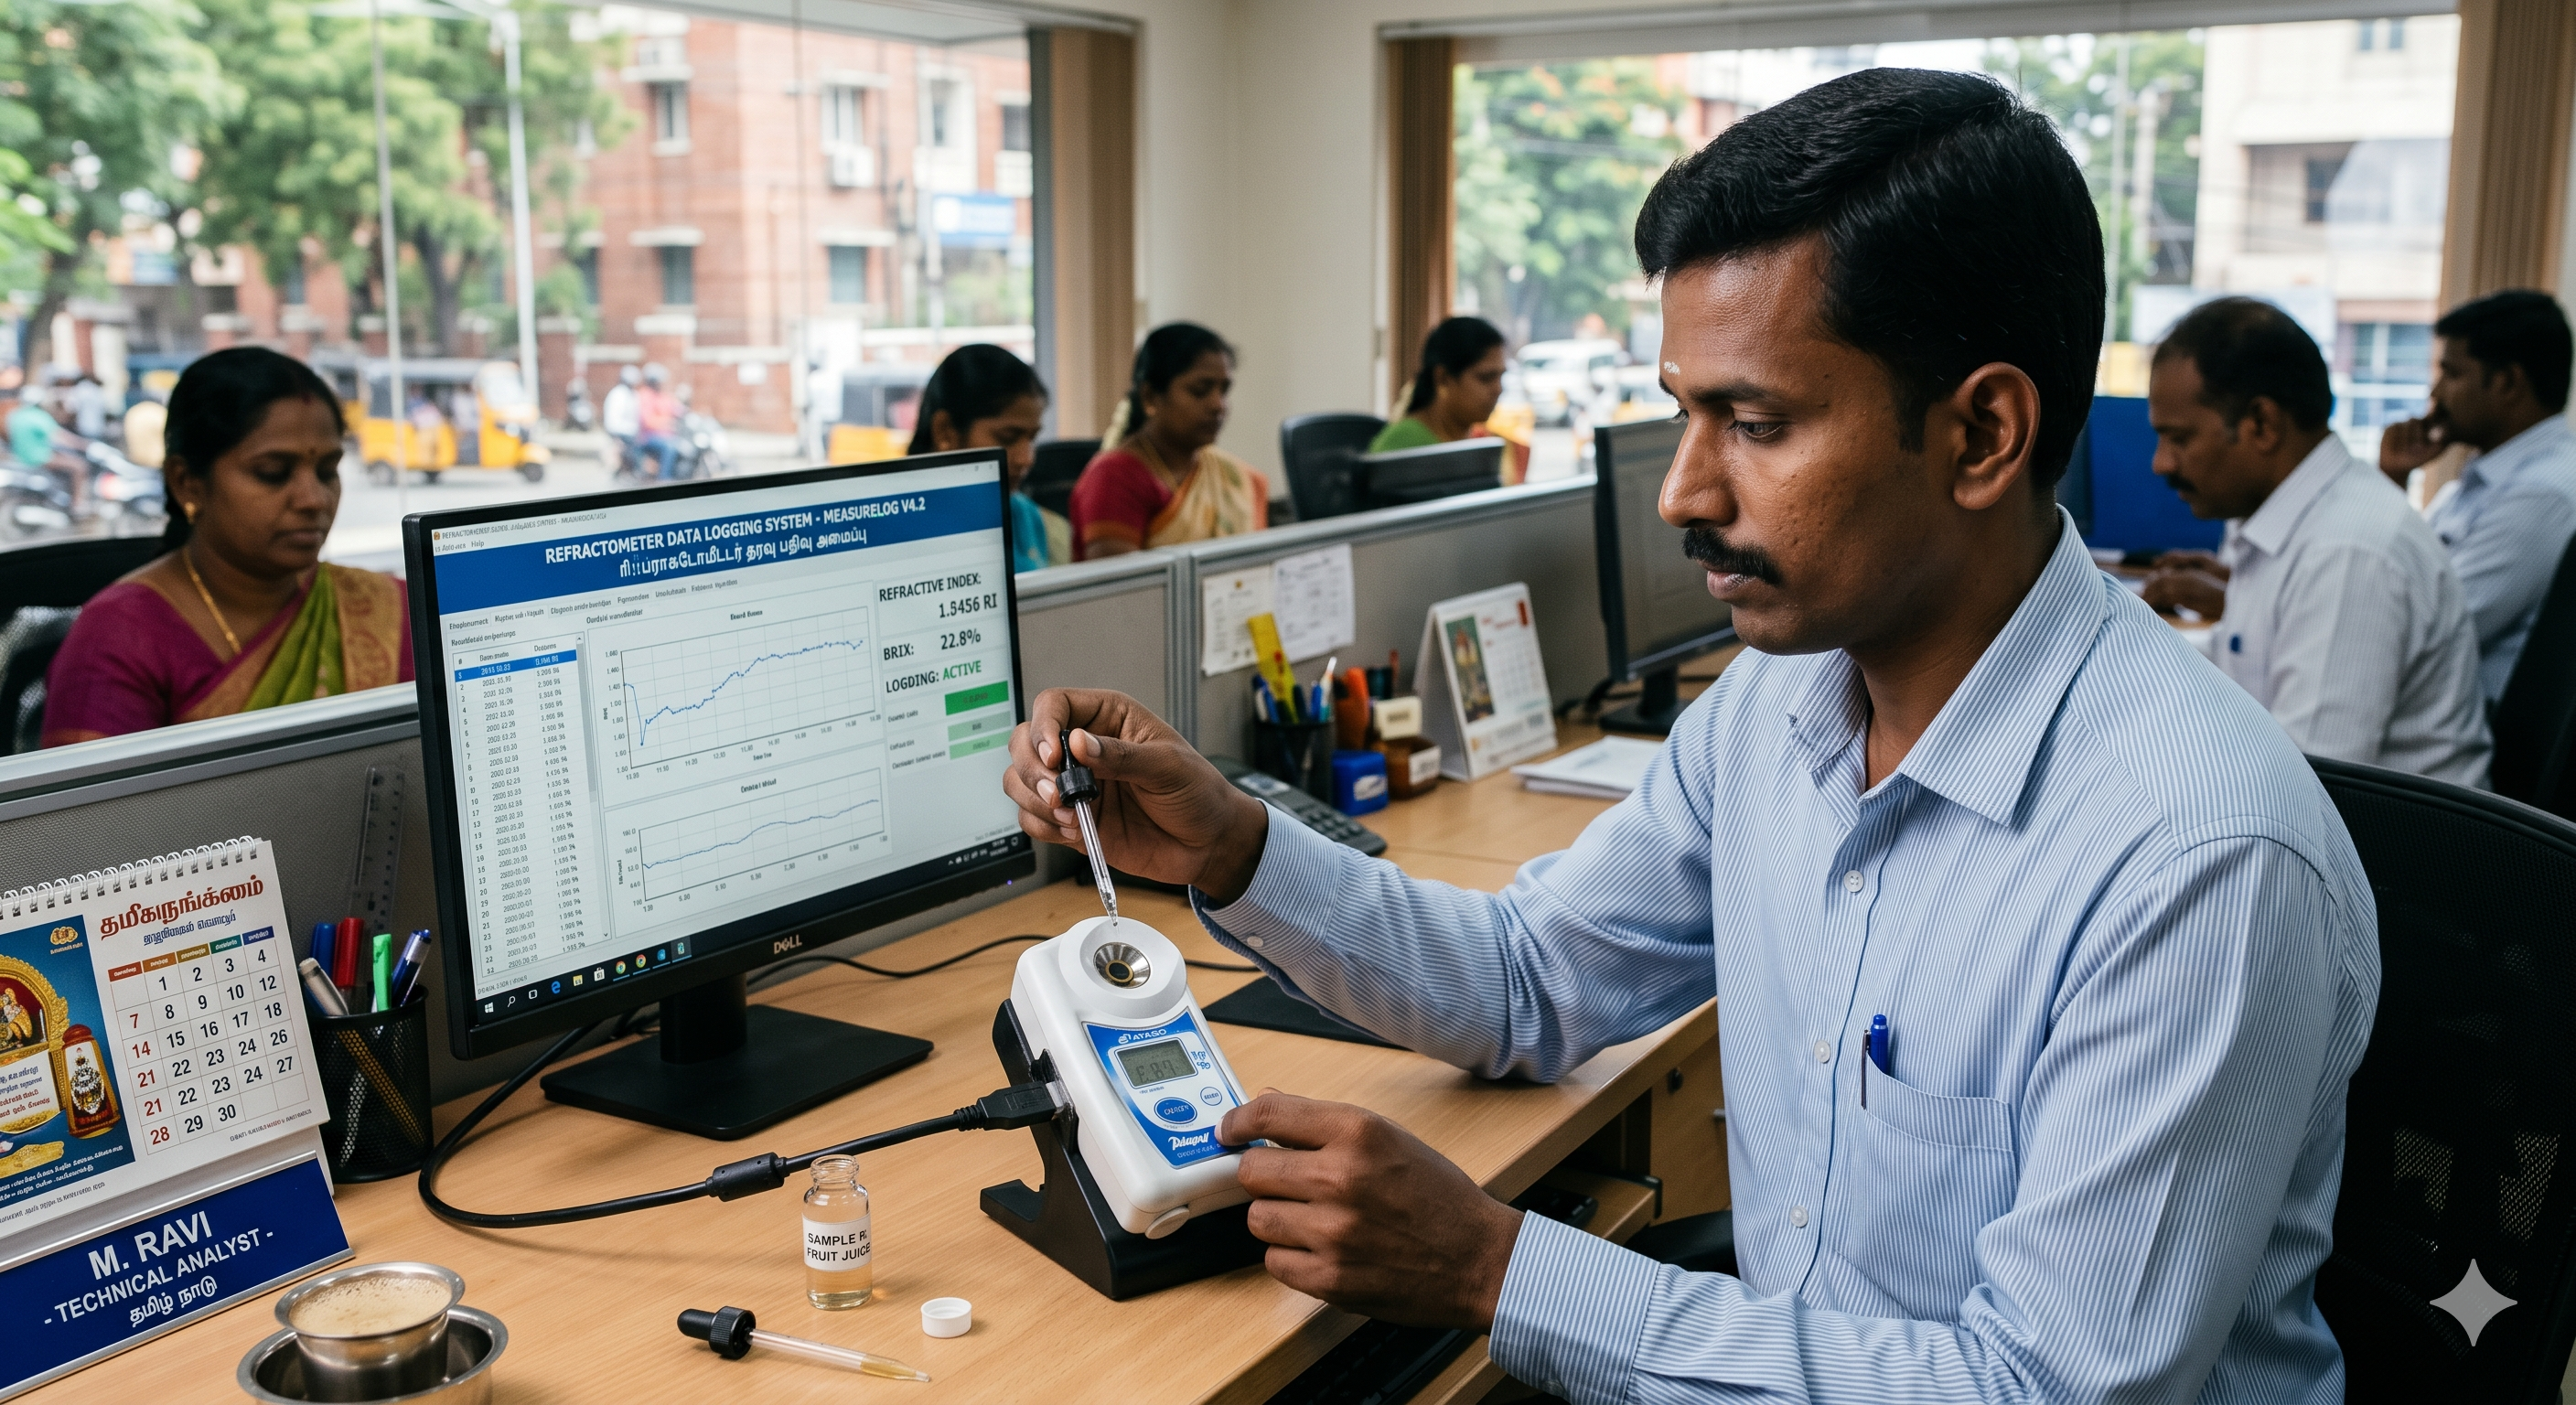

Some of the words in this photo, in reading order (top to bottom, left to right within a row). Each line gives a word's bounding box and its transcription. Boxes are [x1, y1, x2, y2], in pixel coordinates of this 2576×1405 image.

[545, 533, 664, 563] REFRACTOMETER
[667, 528, 703, 547] DATA
[703, 519, 763, 542] LOGGING
[765, 512, 812, 532] SYSTEM
[823, 500, 899, 524] MEASURELOG
[901, 497, 926, 513] V4.2
[879, 578, 944, 602] REFRACTIVE
[947, 573, 982, 590] INDEX:
[983, 593, 997, 609] RI
[884, 643, 914, 660] BRIX:
[940, 628, 981, 649] 22.8%
[886, 671, 939, 693] LOGDING:
[942, 660, 982, 681] ACTIVE
[480, 888, 488, 896] 20
[158, 976, 167, 992] 1
[192, 967, 203, 982] 2
[225, 958, 234, 972] 3
[257, 949, 267, 963] 4
[129, 1014, 139, 1029] 7
[165, 1004, 175, 1020] 8
[198, 994, 208, 1010] 9
[227, 984, 244, 1001] 10
[259, 975, 277, 992] 12
[132, 1041, 151, 1058] 14
[166, 1031, 185, 1048] 15
[200, 1021, 219, 1038] 16
[232, 1012, 249, 1028] 17
[264, 1003, 283, 1019] 18
[137, 1068, 156, 1089] 21
[172, 1059, 191, 1078] 22
[206, 1048, 225, 1067] 23
[238, 1038, 257, 1056] 24
[270, 1029, 288, 1046] 26
[144, 1098, 162, 1117] 21
[177, 1087, 198, 1106] 22
[211, 1076, 231, 1094] 23
[244, 1066, 263, 1084] 24
[276, 1056, 293, 1074] 27
[150, 1126, 170, 1145] 28
[184, 1115, 203, 1133] 29
[218, 1104, 237, 1122] 30
[88, 1244, 130, 1281] M.
[134, 1210, 213, 1263] RAVI
[807, 1247, 838, 1261] FRUIT
[842, 1242, 871, 1261] JUICE
[808, 1232, 856, 1246] SAMPLE
[54, 1265, 173, 1324] TECHNICAL
[177, 1228, 261, 1278] ANALYST
[129, 1292, 174, 1328] தமிழ்
[177, 1275, 218, 1309] நாடு
